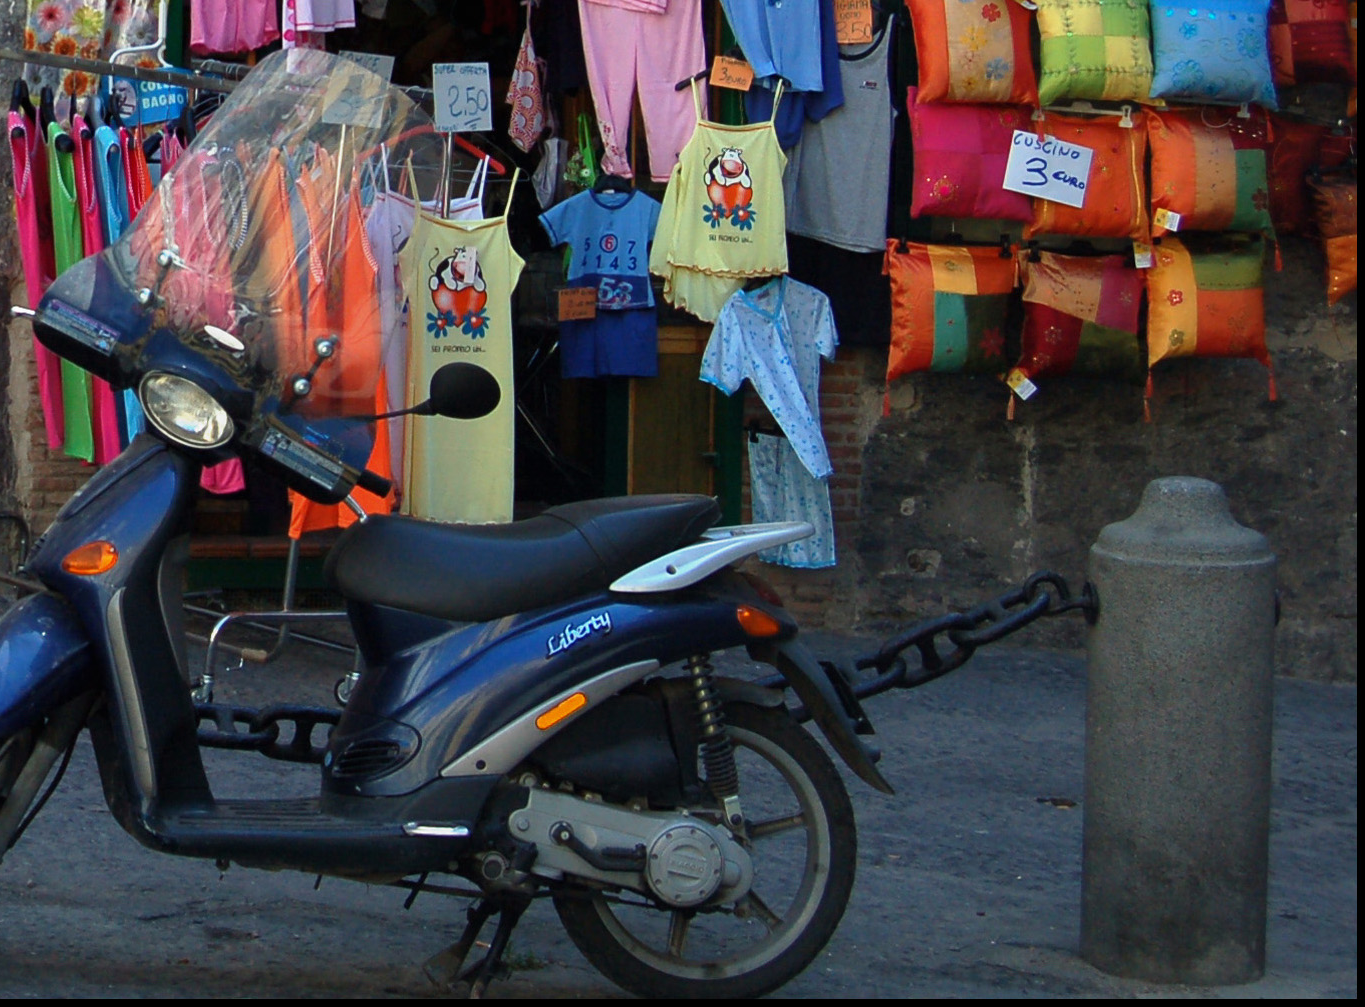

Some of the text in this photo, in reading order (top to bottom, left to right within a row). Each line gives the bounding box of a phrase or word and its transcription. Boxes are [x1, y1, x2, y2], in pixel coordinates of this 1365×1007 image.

[836, 0, 870, 11] IGIAMA
[142, 93, 185, 110] BAGNO
[1013, 132, 1081, 160] CUSCINO
[1022, 156, 1049, 187] 3
[627, 240, 637, 254] 7
[547, 611, 612, 657] Liberty
